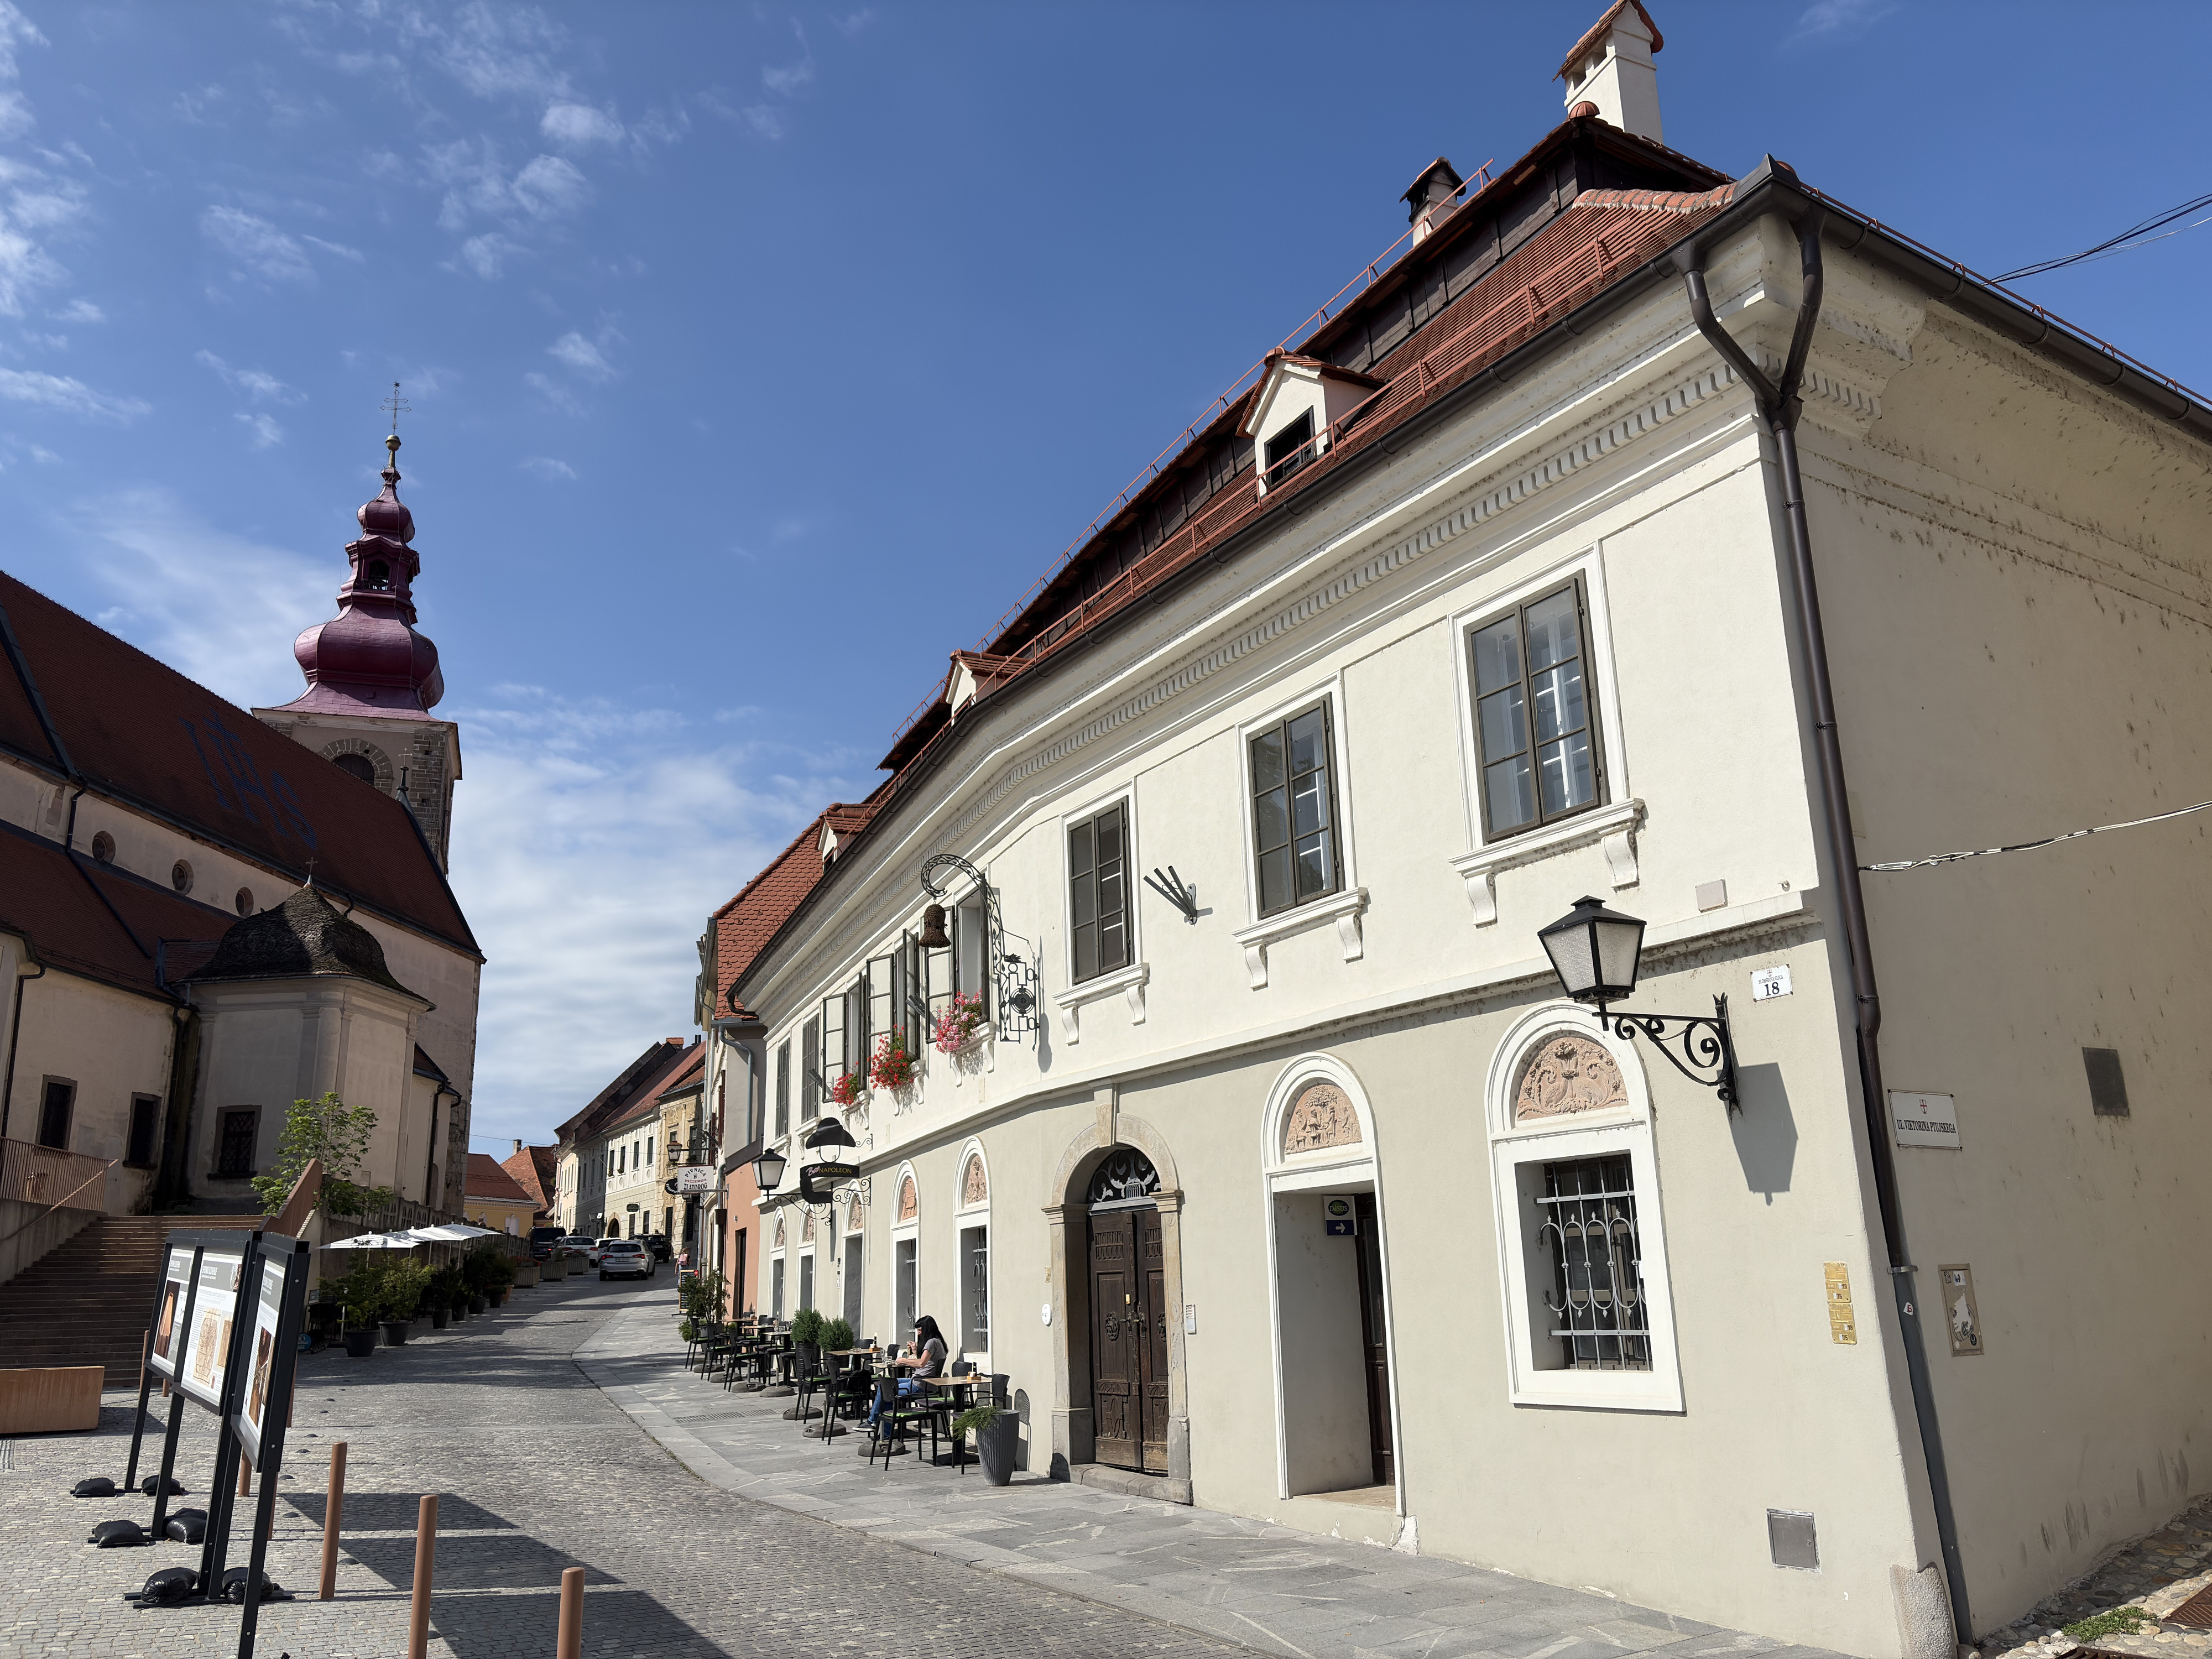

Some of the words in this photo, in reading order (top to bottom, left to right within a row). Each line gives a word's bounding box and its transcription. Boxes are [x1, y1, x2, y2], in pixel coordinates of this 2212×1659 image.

[1764, 982, 1780, 996] 18
[1904, 1120, 1931, 1131] VIKTORINA
[1929, 1121, 1956, 1133] PTUJSKEGA
[685, 1167, 706, 1177] PIVNICA
[806, 1165, 820, 1176] Bar
